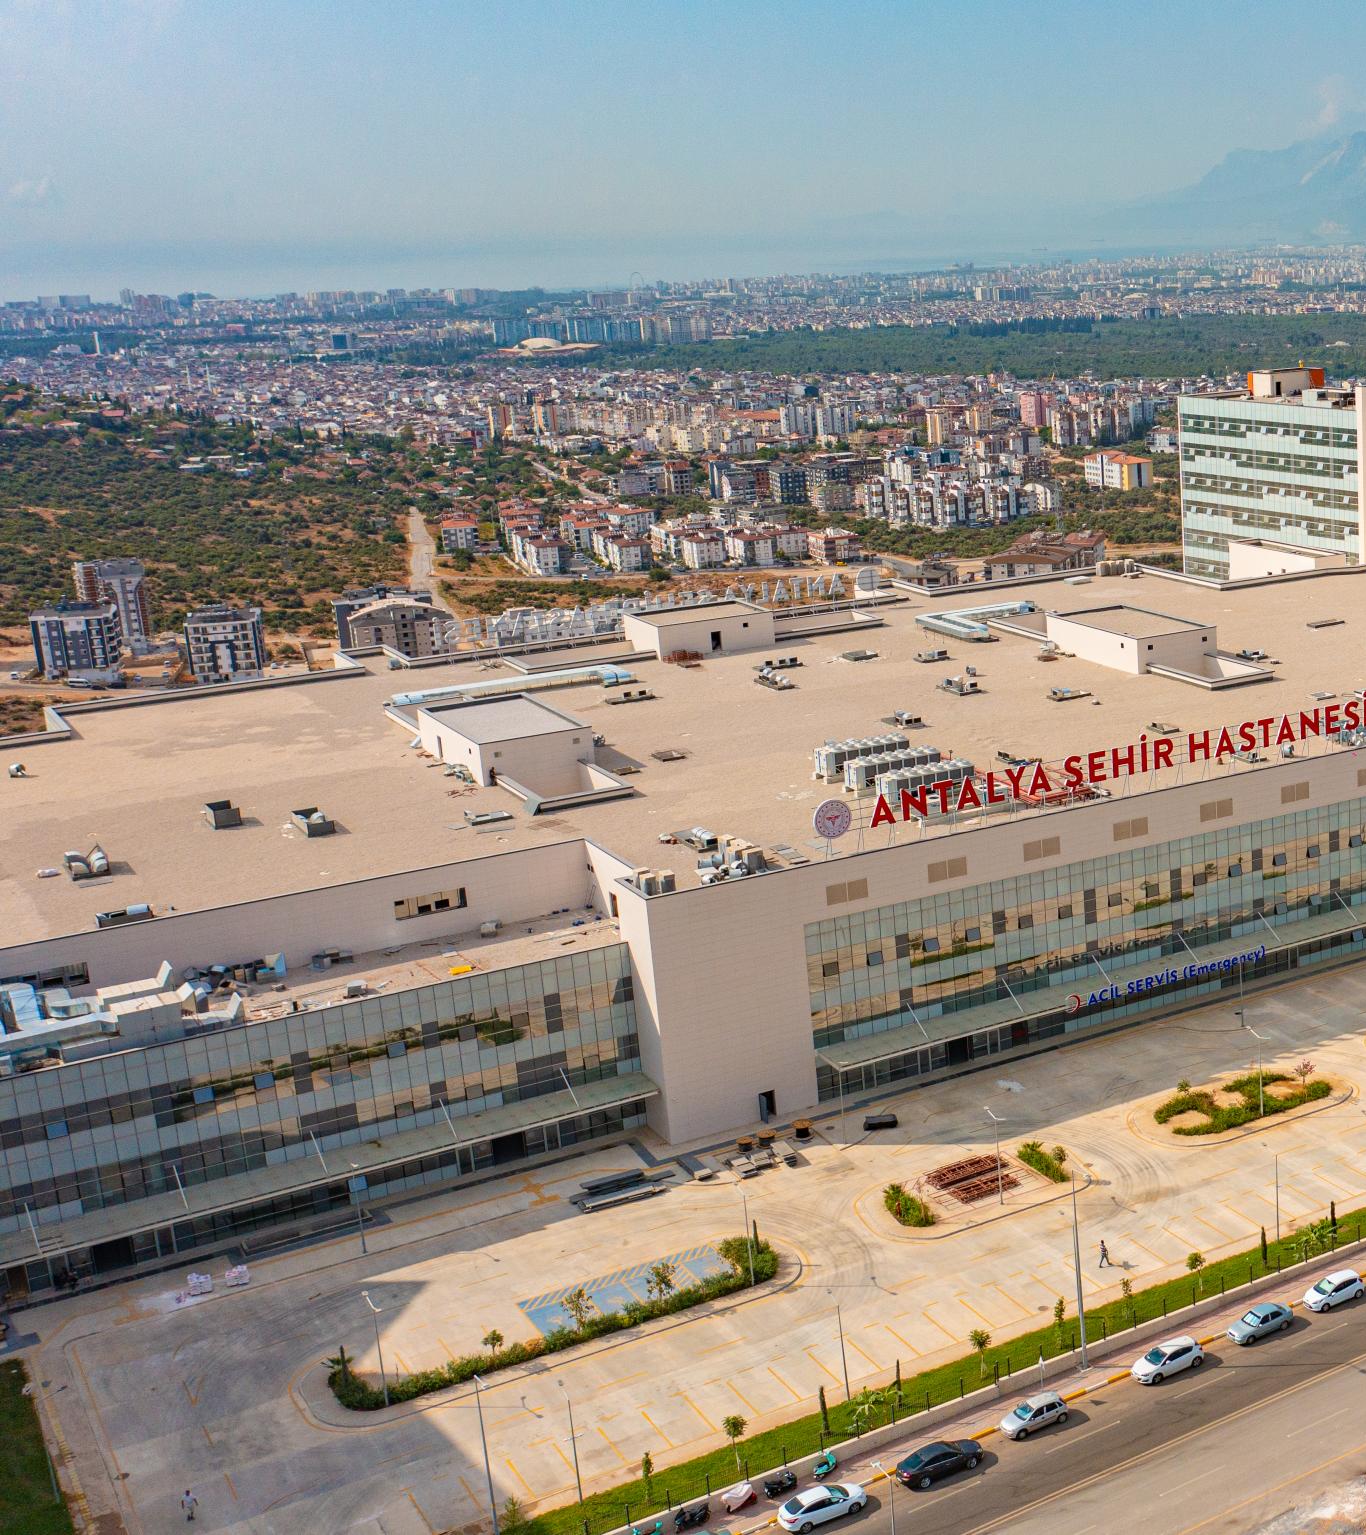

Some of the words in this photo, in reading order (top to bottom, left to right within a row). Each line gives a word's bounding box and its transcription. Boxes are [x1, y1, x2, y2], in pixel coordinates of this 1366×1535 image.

[870, 762, 1052, 828] ANTALYA
[1063, 734, 1174, 792] ŞEHİR
[1087, 984, 1121, 1006] ACİL
[1127, 968, 1178, 994] SERVİS
[1183, 945, 1266, 980] (Emergency)
